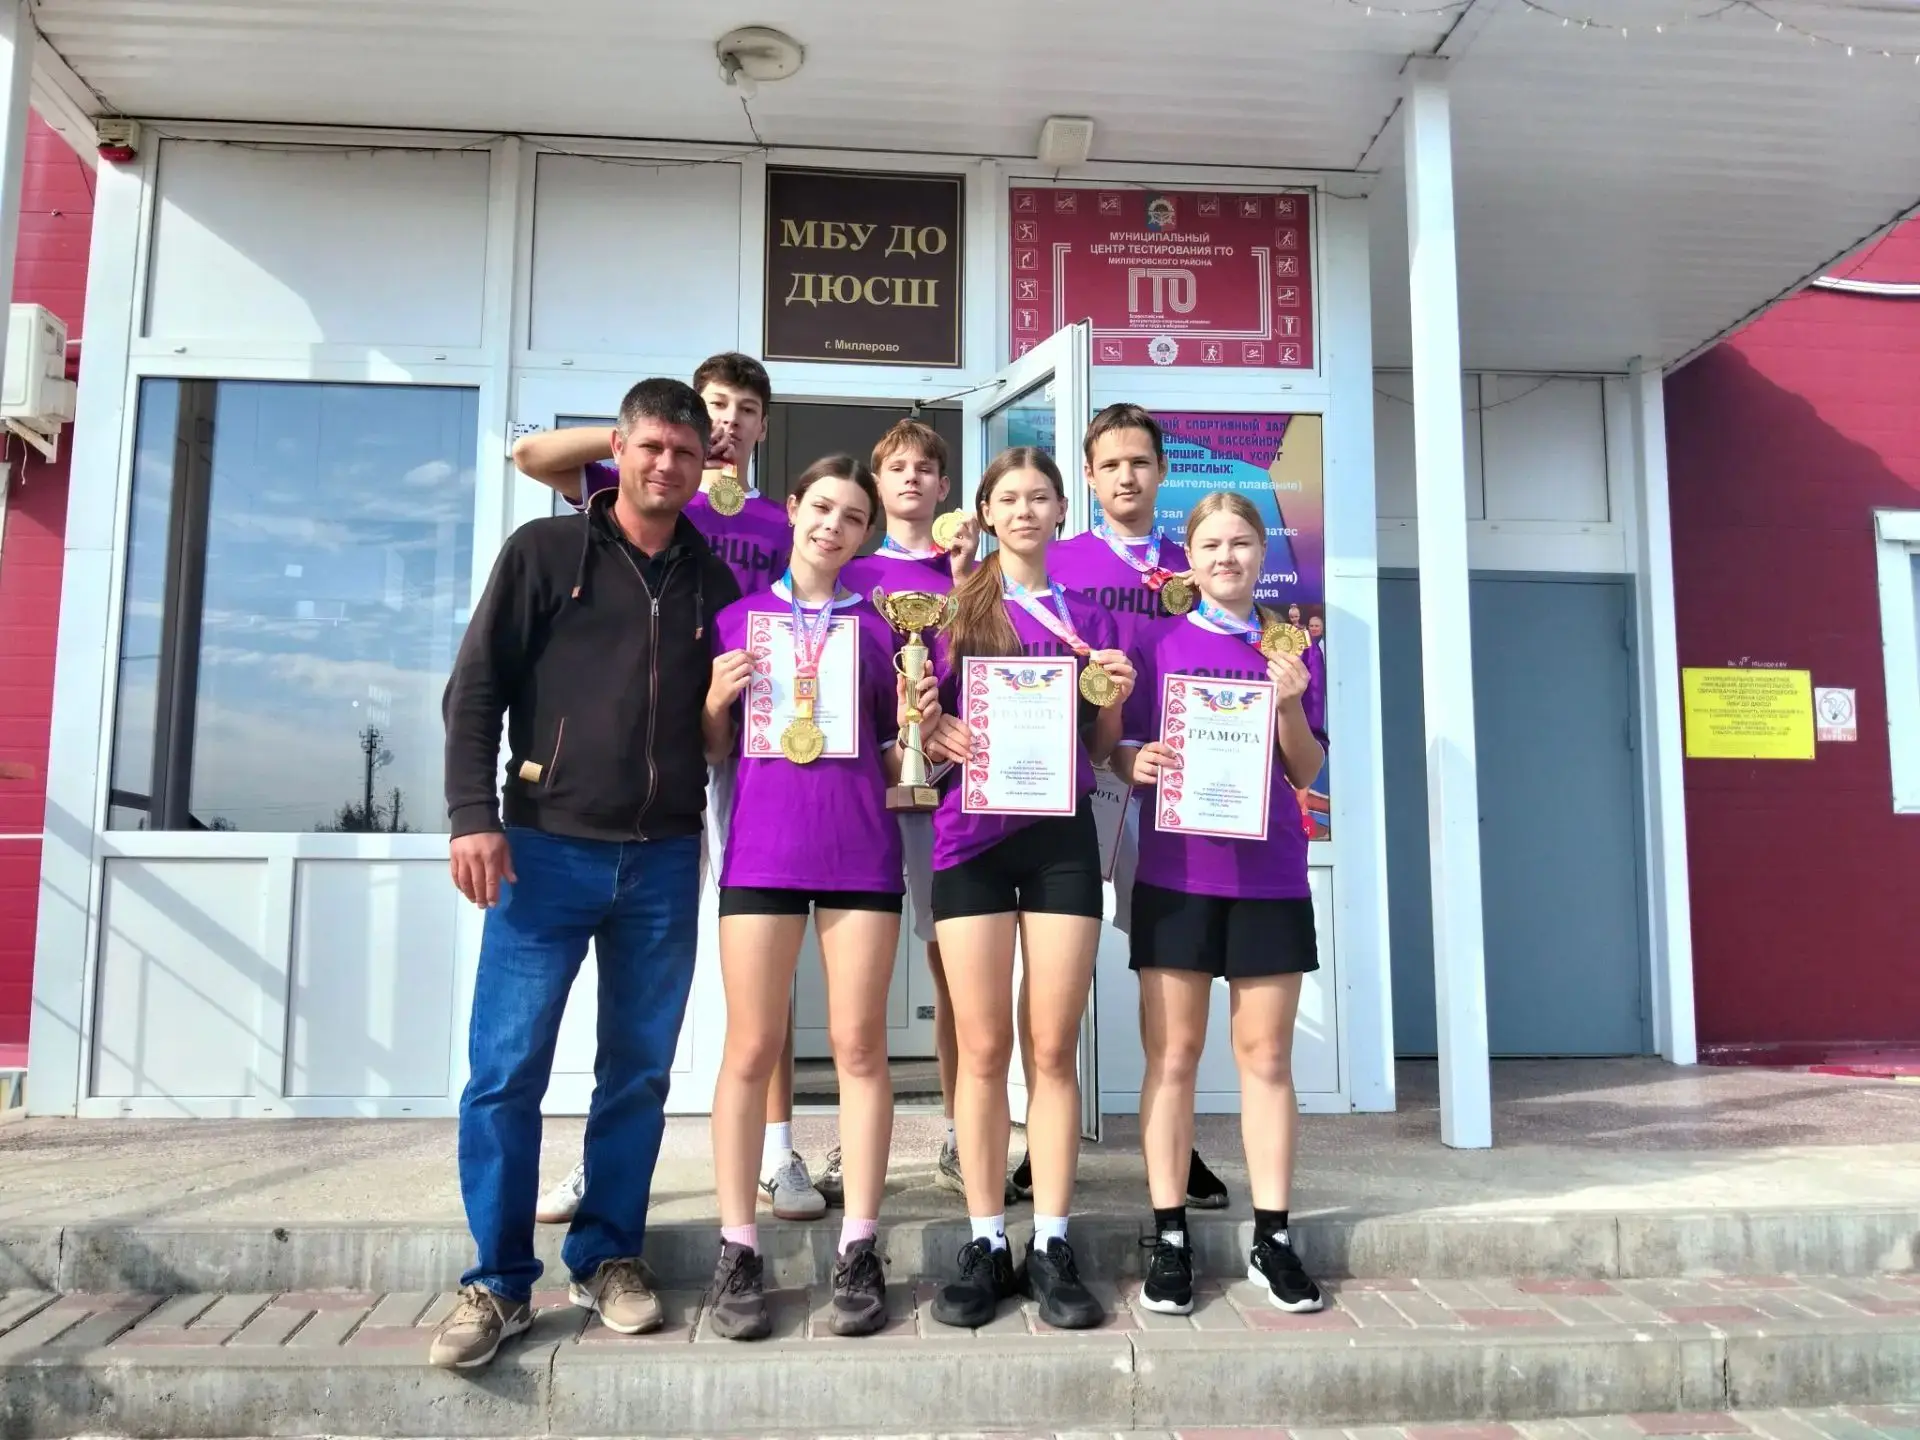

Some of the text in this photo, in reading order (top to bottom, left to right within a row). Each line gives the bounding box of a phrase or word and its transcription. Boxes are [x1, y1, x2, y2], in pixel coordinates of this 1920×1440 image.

[779, 218, 947, 260] МБУ ДО
[1109, 231, 1210, 243] МУНИЦИПАЛЬНЫЙ
[1090, 244, 1234, 256] ЦЕНТР ТЕСТИРОВАНИЯ ГТО
[1108, 257, 1213, 267] МИЛЛЕРОВСКОГО РАЙОНА
[785, 272, 940, 308] ДЮСШ
[1128, 267, 1197, 313] ГТО
[825, 339, 900, 353] г. Миллерово
[1186, 417, 1260, 432] СПОРТИВНЫЙ
[1265, 421, 1287, 432] ЗАЛ
[1163, 433, 1284, 447] ЕЛЬНЫМ БАССЕЙНОМ
[1211, 449, 1244, 461] ВИДЫ
[1249, 451, 1284, 462] УСЛУГ
[1170, 463, 1234, 475] ВЗРОСЛЫХ:
[1159, 479, 1303, 492] овительное плавание)
[1161, 510, 1184, 519] зал
[705, 534, 778, 577] НЦЫ
[1188, 727, 1261, 744] ГРАМОТА
[1089, 788, 1120, 803] ОТА
